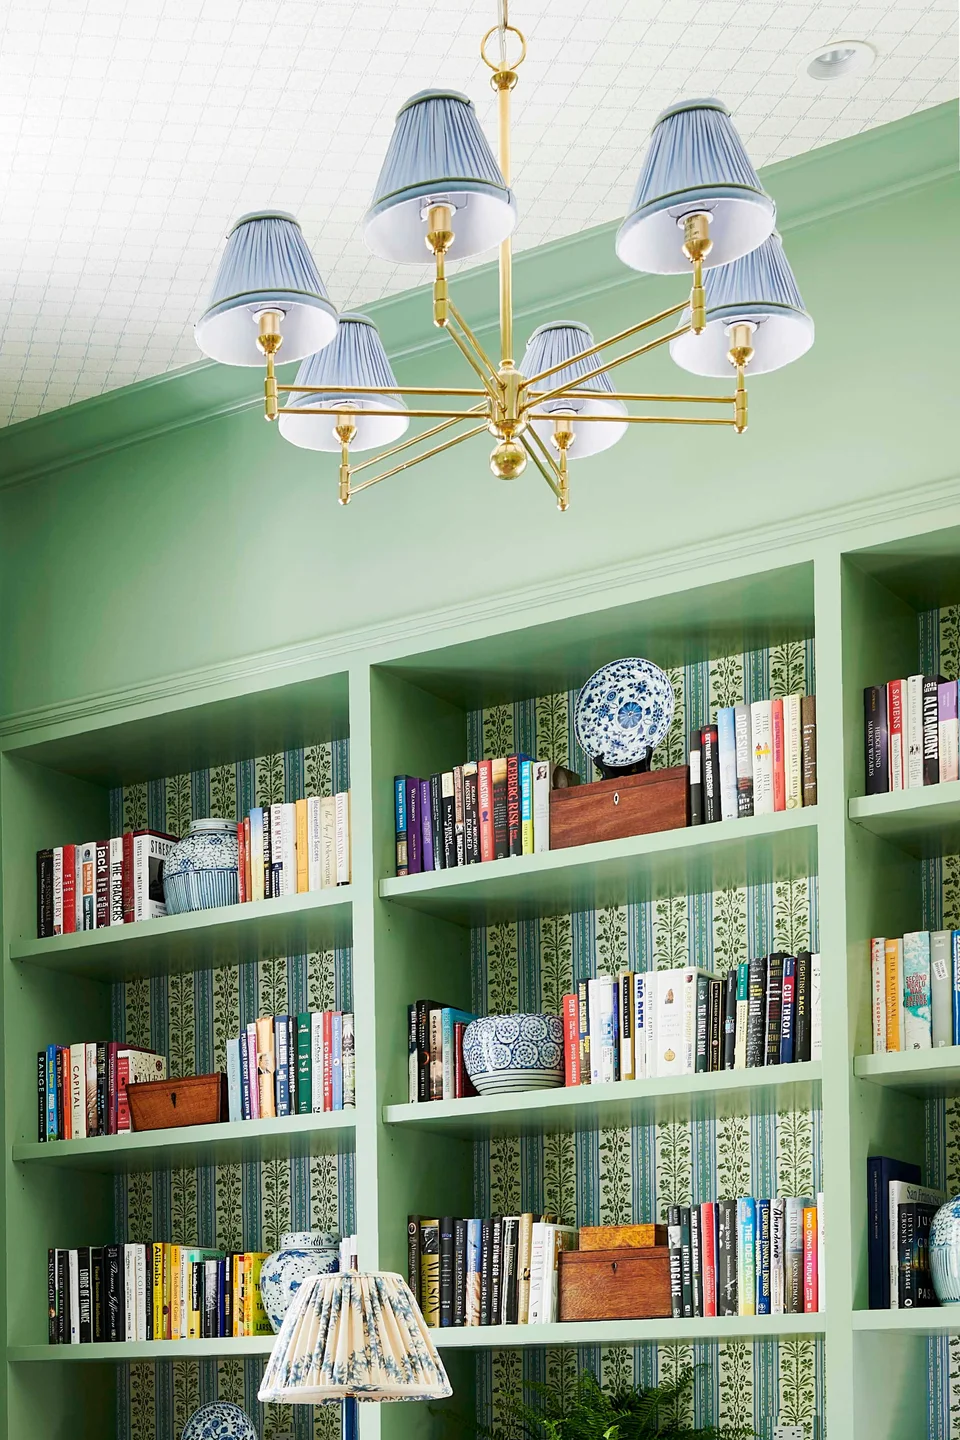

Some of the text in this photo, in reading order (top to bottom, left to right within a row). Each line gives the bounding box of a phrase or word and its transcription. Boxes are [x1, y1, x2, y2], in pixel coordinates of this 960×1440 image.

[892, 689, 900, 729] SAPIENS
[923, 696, 938, 759] ALTAMONT
[737, 714, 747, 763] DOPESICK
[480, 766, 488, 808] BRAINSTORM
[508, 756, 519, 827] ICEBERG RISK
[97, 846, 108, 873] jack
[324, 841, 332, 873] Deleveraging
[112, 860, 123, 921] THE FRACKERS
[876, 967, 880, 975] IS
[579, 1001, 587, 1034] GRISHAM
[906, 1000, 927, 1008] BEEVOR
[698, 1004, 706, 1056] THE JUNGLE BOOK
[97, 1047, 105, 1075] HANG TIME
[761, 1208, 769, 1239] CORPORATE
[773, 1208, 783, 1259] Abundance
[745, 1243, 753, 1264] IDEA
[79, 1268, 89, 1288] LORDS
[108, 1260, 119, 1327] Thomas Jefferson
[428, 1262, 439, 1314] WILSON
[670, 1255, 681, 1297] ENDGAME
[745, 1265, 753, 1304] FACTORY
[80, 1299, 90, 1323] FINANCE
